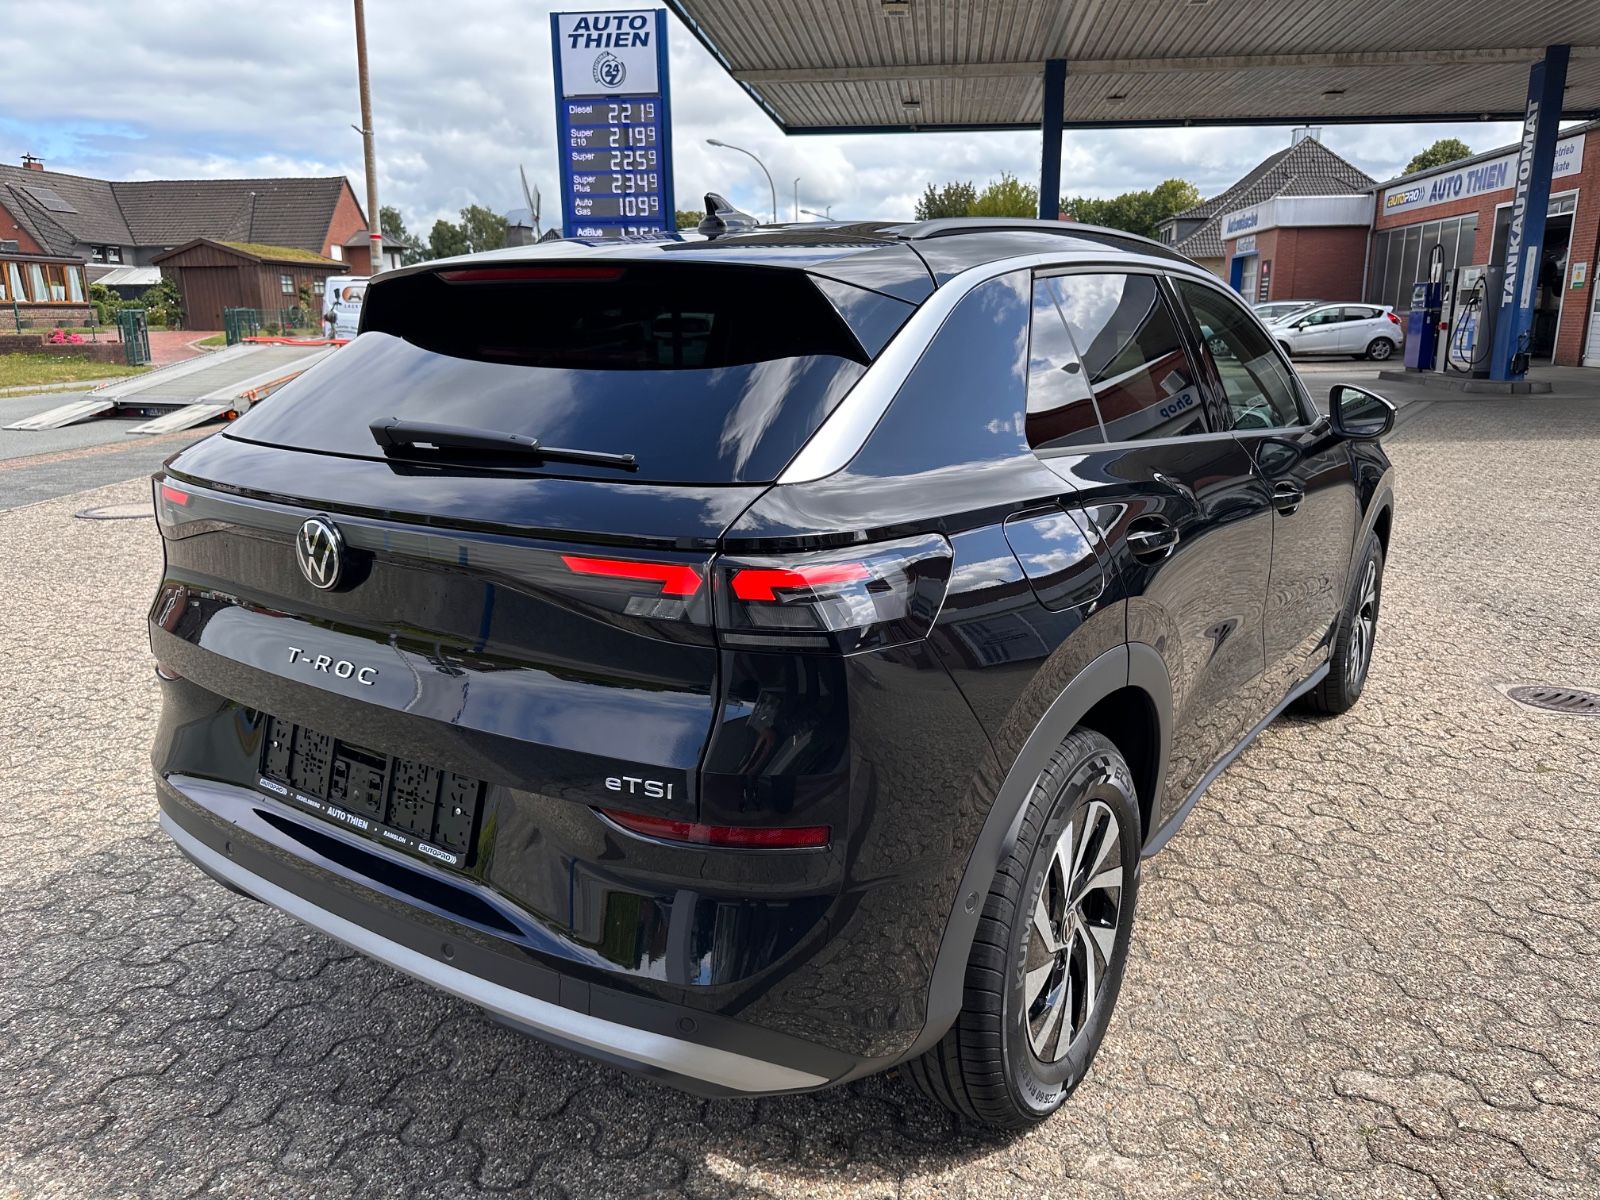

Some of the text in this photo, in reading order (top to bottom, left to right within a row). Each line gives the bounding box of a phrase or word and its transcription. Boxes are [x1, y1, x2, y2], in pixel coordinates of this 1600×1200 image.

[572, 15, 648, 32] AUTO
[567, 32, 651, 49] THIEN
[568, 105, 593, 114] Diesel
[570, 128, 594, 138] Super
[571, 139, 587, 147] E10
[571, 152, 595, 161] Super
[573, 175, 597, 184] Super
[1429, 173, 1463, 202] AUTO
[1466, 161, 1509, 194] THIEN
[573, 184, 591, 193] Plus
[575, 198, 593, 207] Auto
[1502, 98, 1539, 308] TANKAUTOMAT
[575, 207, 592, 216] Gas
[577, 227, 603, 237] AdBlue
[288, 646, 379, 686] T-ROC
[605, 776, 673, 800] eTSI
[327, 806, 347, 821] AUTO
[346, 813, 369, 830] THIEN
[1015, 871, 1044, 990] KUMHO
